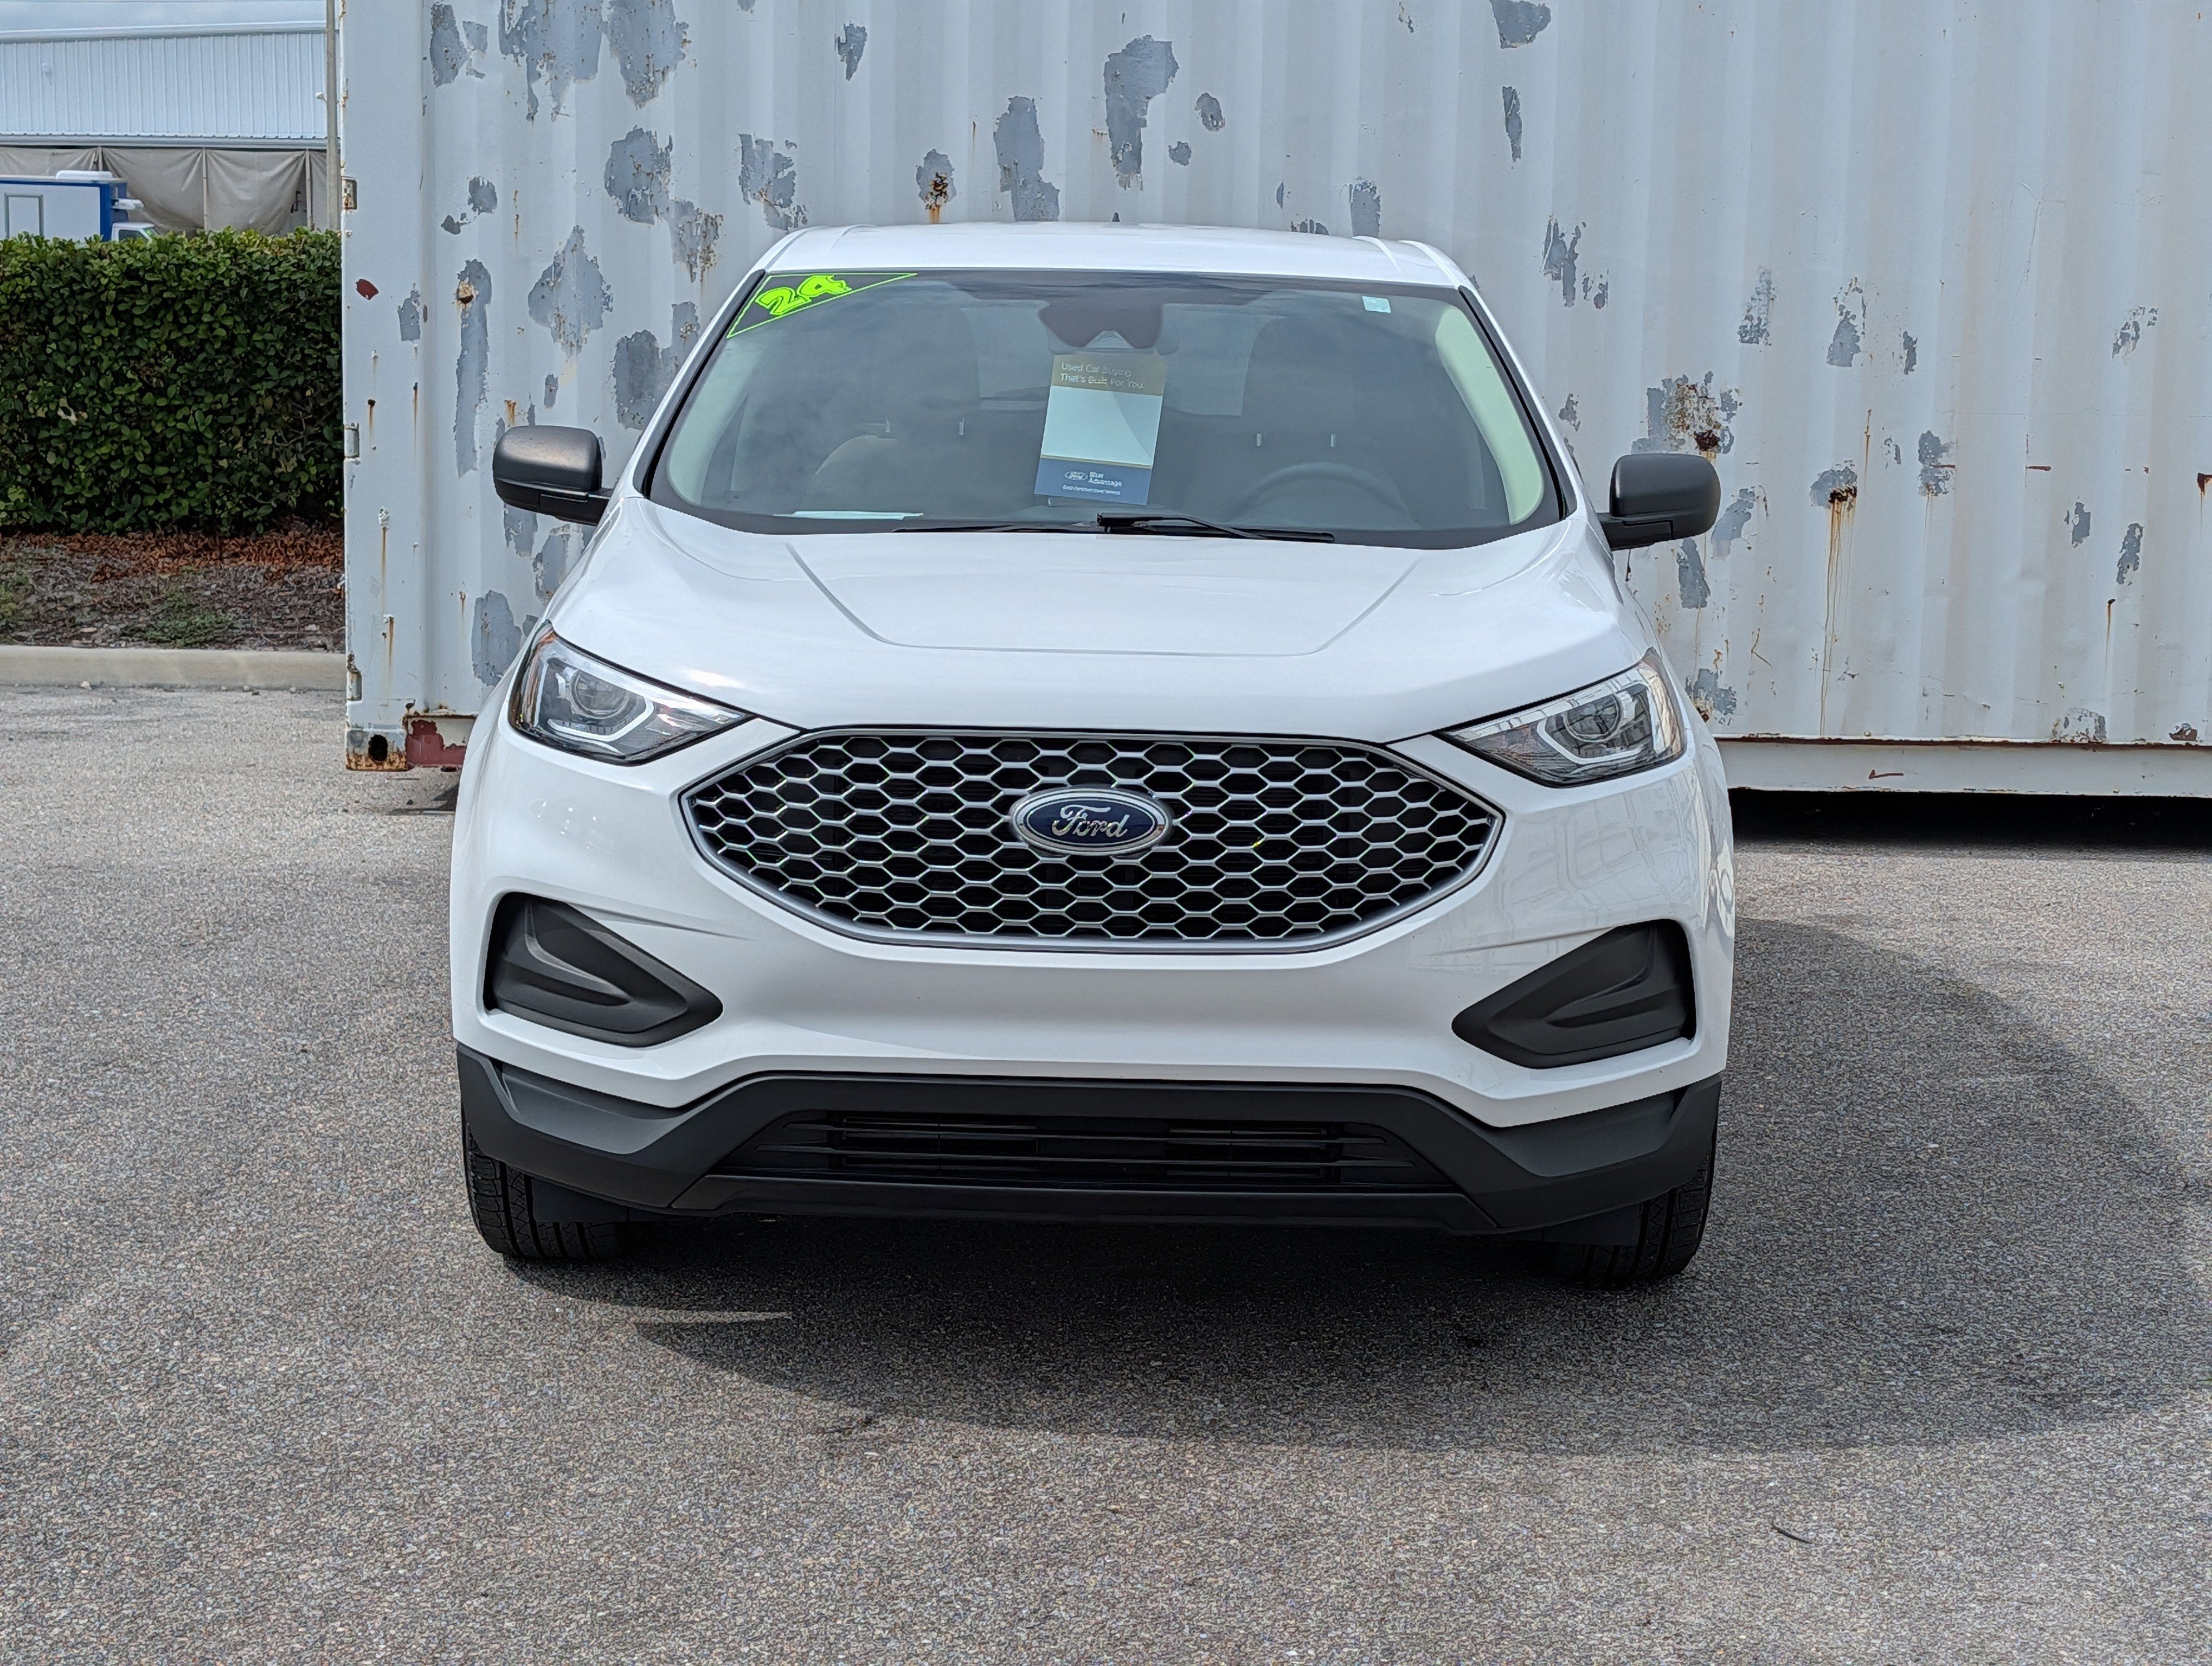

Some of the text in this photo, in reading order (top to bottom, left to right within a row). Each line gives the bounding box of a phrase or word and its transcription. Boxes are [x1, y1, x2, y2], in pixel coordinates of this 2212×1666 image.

[755, 274, 852, 316] 24
[1062, 362, 1132, 377] Used Car Buying
[1110, 378, 1126, 386] For
[1052, 804, 1130, 837] Ford
